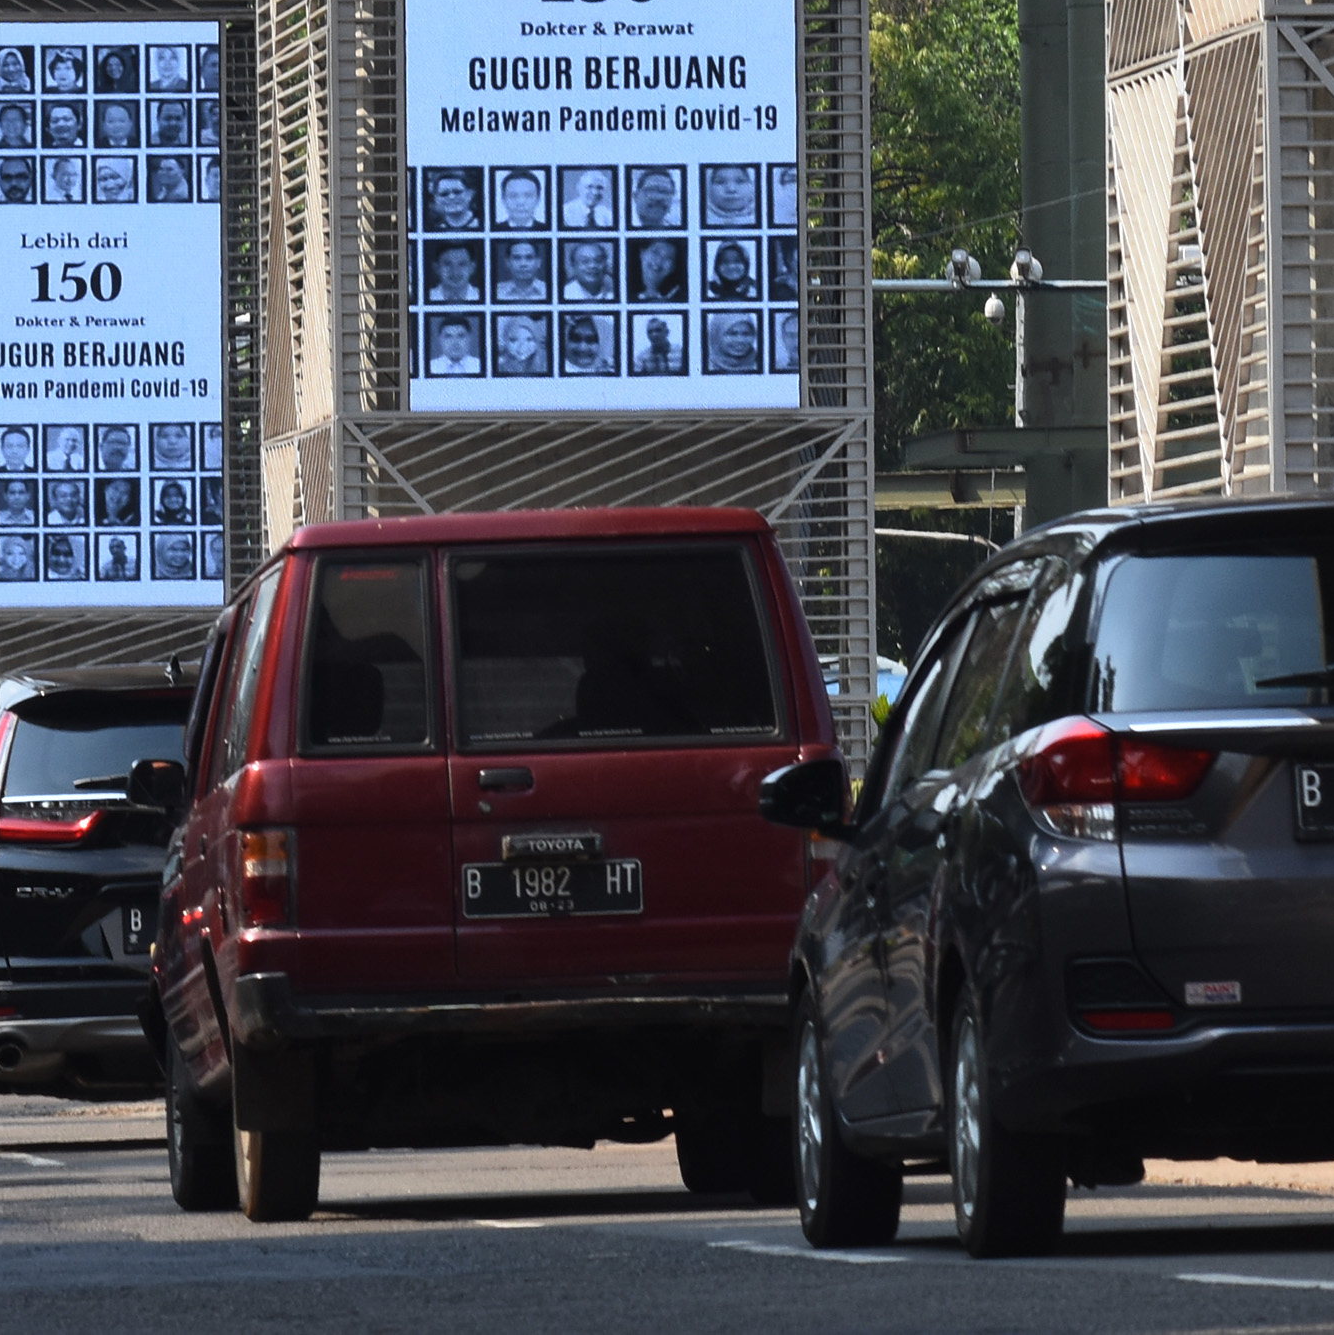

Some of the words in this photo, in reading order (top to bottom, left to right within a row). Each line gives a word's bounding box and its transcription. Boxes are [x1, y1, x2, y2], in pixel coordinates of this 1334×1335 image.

[520, 21, 587, 36] Dokter
[592, 21, 607, 36] &
[614, 21, 694, 36] Perawat
[468, 56, 573, 91] GUGUR
[584, 55, 746, 90] BERJUANG
[440, 106, 551, 133] Melawan
[559, 104, 666, 132] Pandemi
[674, 104, 778, 131] Covid-19
[21, 232, 80, 249] Lebih
[87, 231, 128, 249] dari
[30, 261, 122, 303] 150
[15, 316, 63, 327] Dokter
[85, 315, 145, 327] Perawat
[63, 340, 185, 368] BERJUANG
[44, 377, 125, 399] Pandemi
[130, 377, 208, 399] Covid-19
[1302, 770, 1321, 807] B
[528, 839, 585, 852] TOYOTA
[466, 868, 481, 899] B
[513, 868, 570, 898] 1982
[606, 862, 636, 894] HT
[130, 909, 142, 932] B
